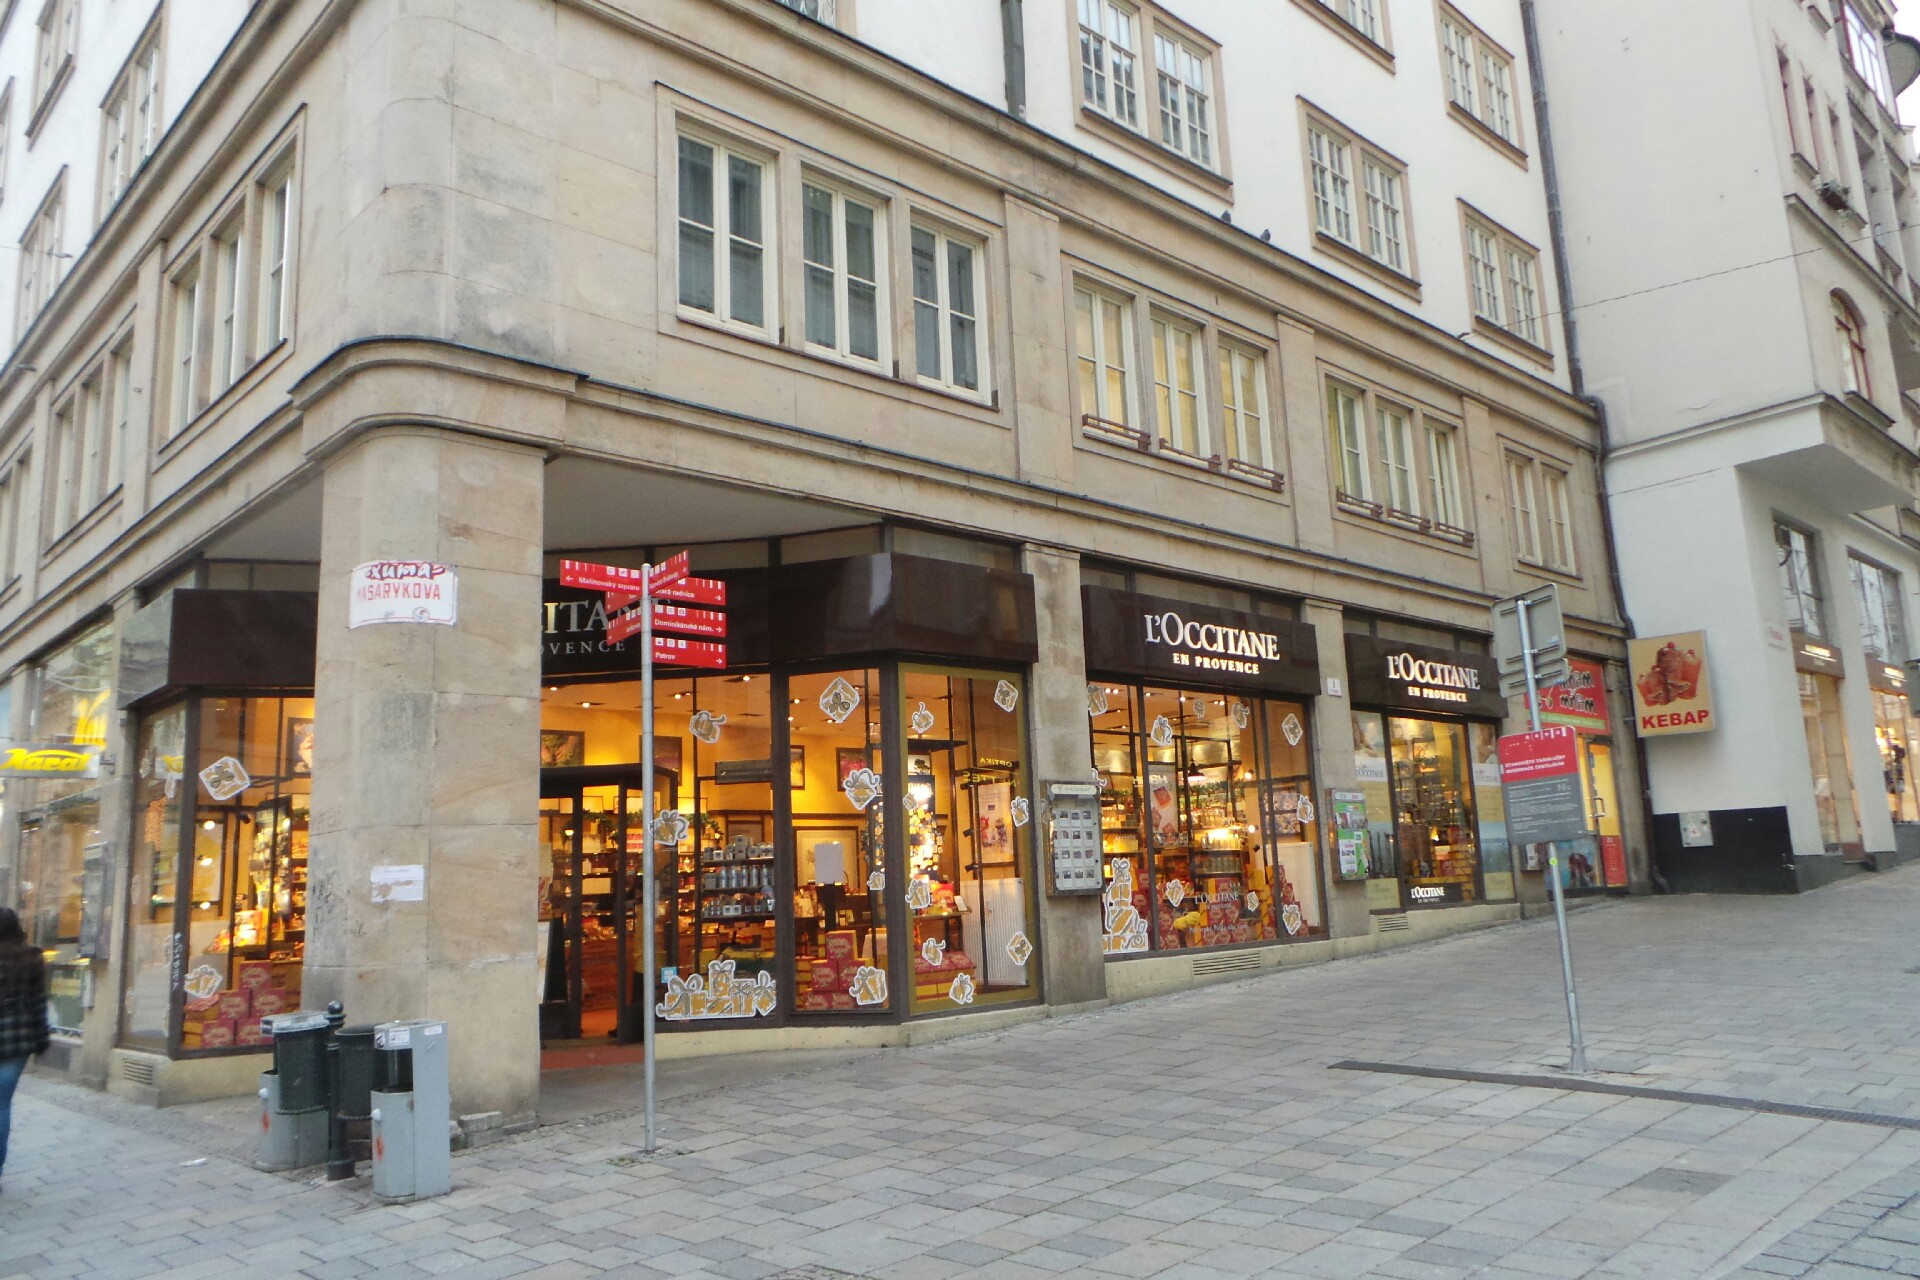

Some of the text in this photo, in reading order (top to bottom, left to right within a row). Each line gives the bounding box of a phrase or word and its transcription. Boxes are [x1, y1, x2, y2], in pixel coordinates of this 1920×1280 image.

[578, 576, 640, 591] Malinovsky square
[1144, 612, 1280, 661] L'OCCITANE
[541, 640, 625, 656] VENCE
[655, 651, 676, 661] Petrov
[1173, 652, 1260, 675] EN PROVENCE
[1386, 652, 1481, 690] L'OCCITANE
[1407, 685, 1468, 703] EN PROVENCE
[1642, 709, 1710, 730] KEBAP
[1411, 886, 1445, 899] L'OCCITANE
